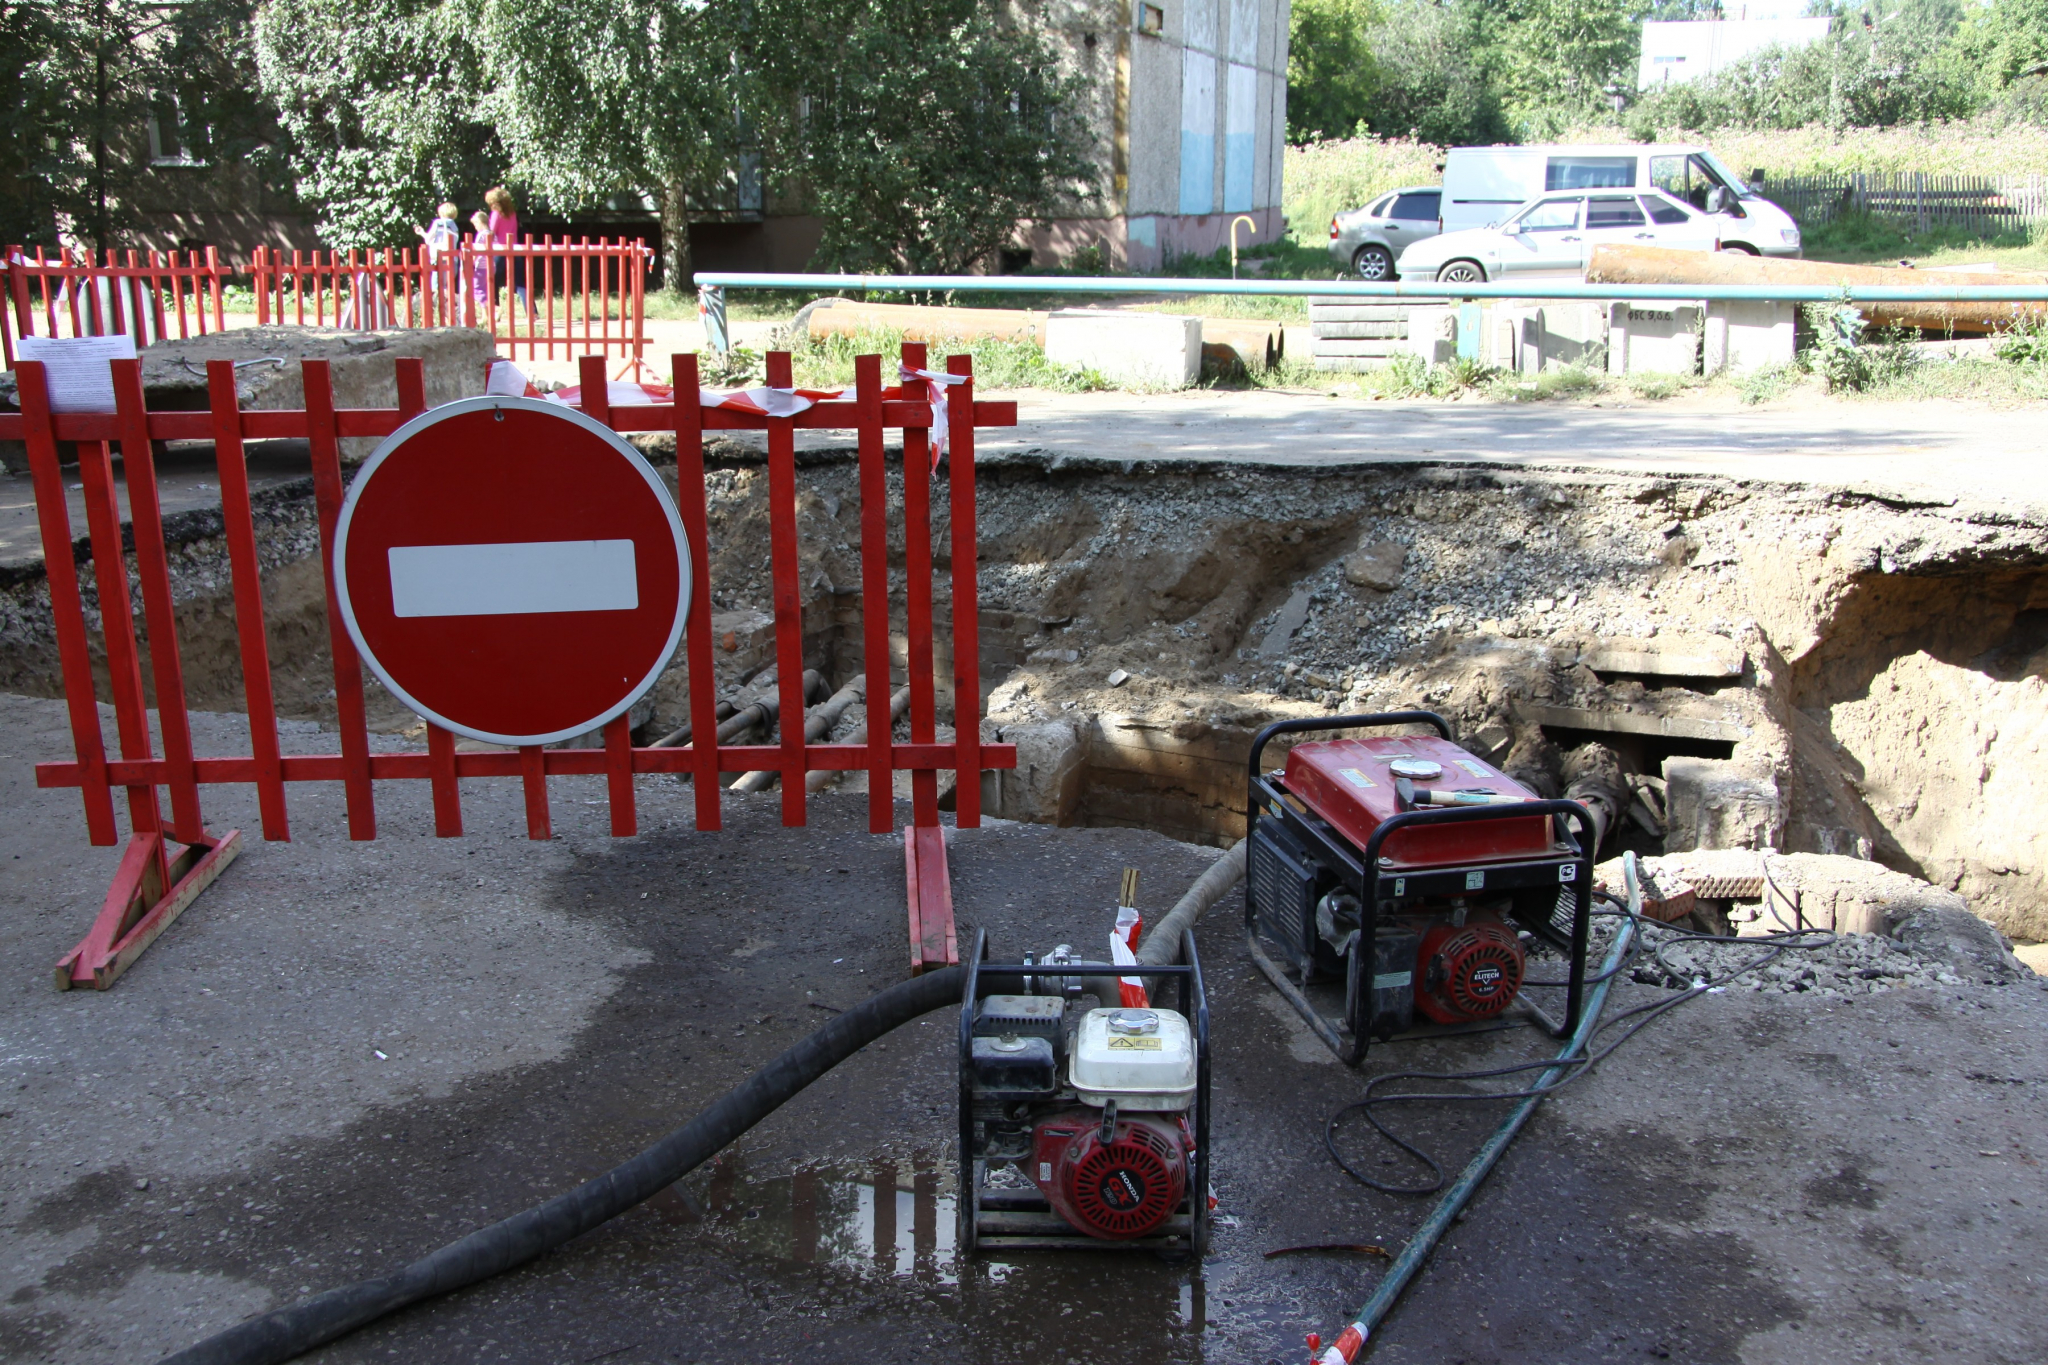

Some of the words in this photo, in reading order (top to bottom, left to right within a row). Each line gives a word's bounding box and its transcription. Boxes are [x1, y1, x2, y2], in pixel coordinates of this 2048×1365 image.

[1627, 310, 1645, 322] ФБС
[1474, 972, 1500, 981] ELITECH
[1108, 1177, 1133, 1206] GX
[1119, 1171, 1140, 1203] HONDA
